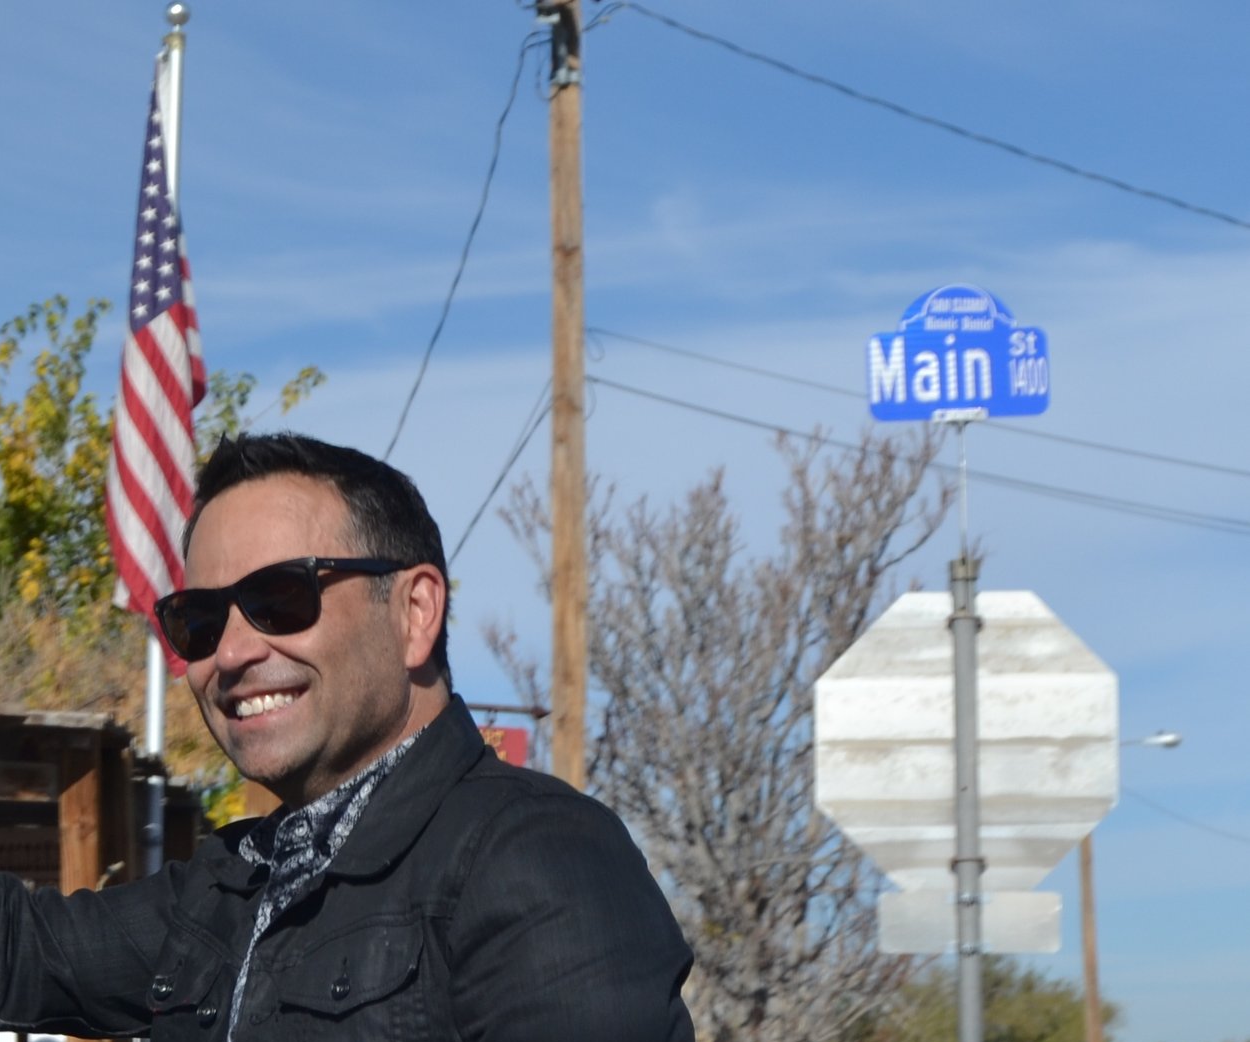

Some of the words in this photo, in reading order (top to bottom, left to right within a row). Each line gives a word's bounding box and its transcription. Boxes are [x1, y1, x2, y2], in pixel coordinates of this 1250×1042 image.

[869, 333, 992, 404] Main
[1009, 331, 1037, 356] St
[1009, 357, 1048, 396] 1400
